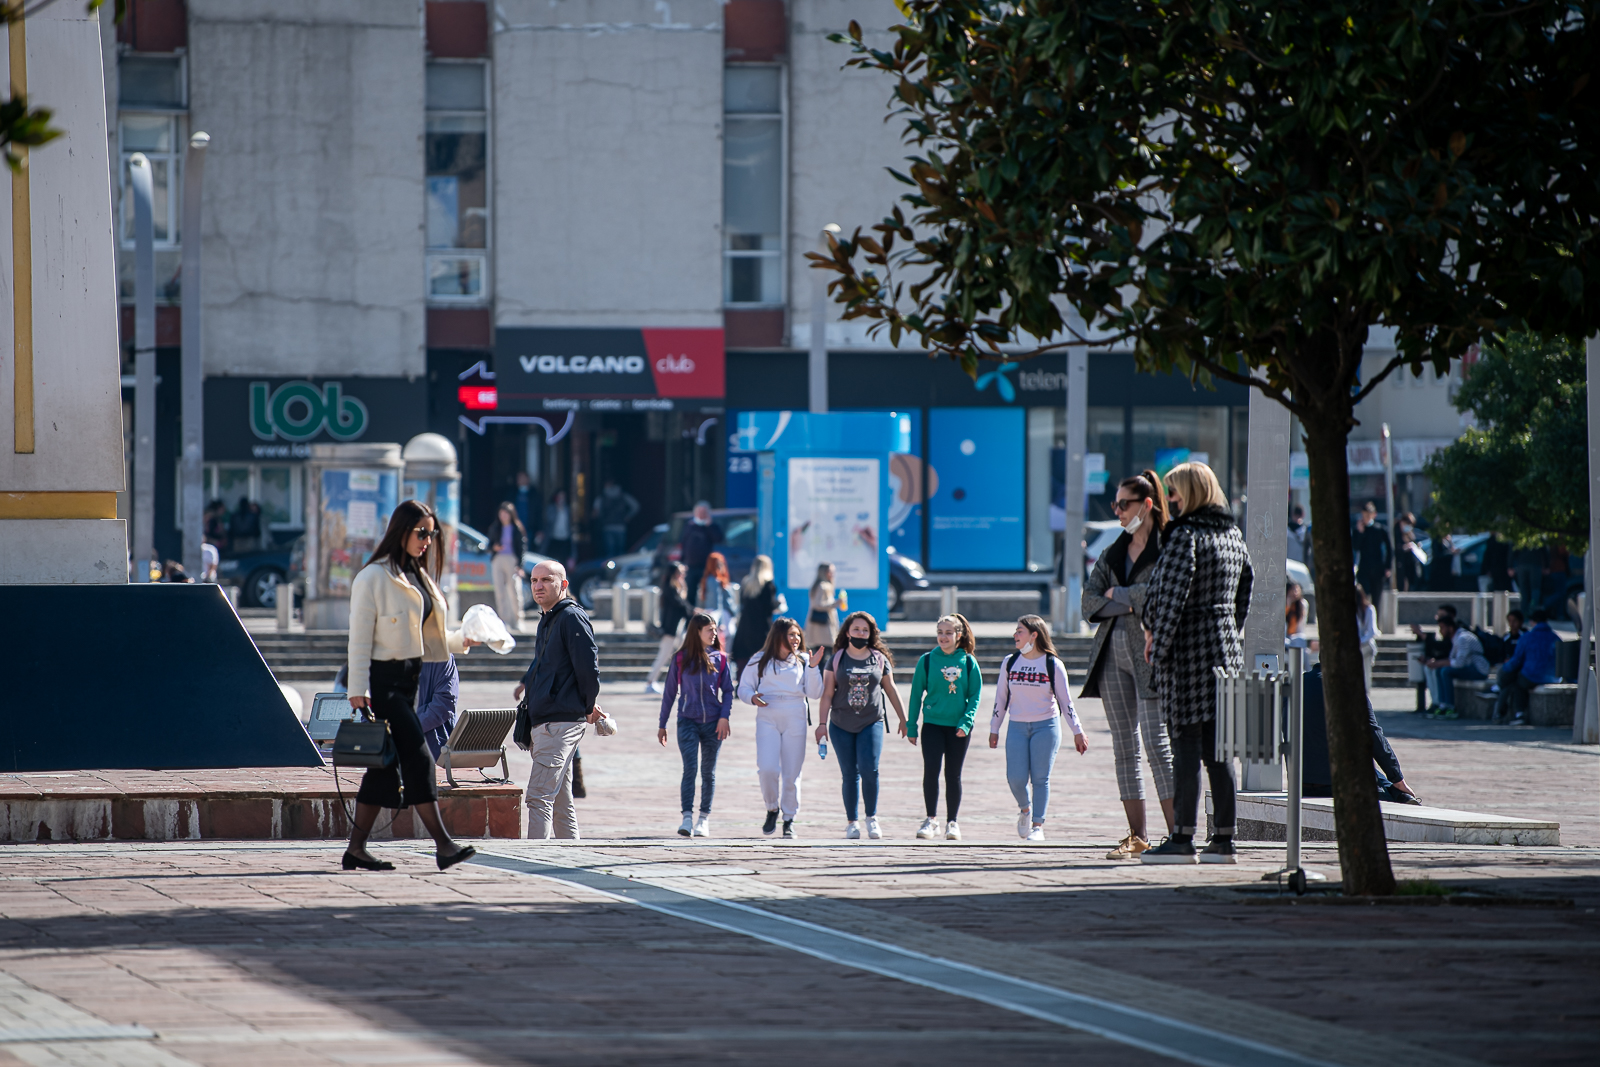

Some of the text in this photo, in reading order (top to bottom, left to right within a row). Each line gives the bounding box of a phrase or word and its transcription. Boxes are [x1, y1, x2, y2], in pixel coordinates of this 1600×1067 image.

[519, 353, 696, 374] VOLCANO club
[1020, 368, 1067, 391] telen
[1010, 671, 1046, 684] TRUE
